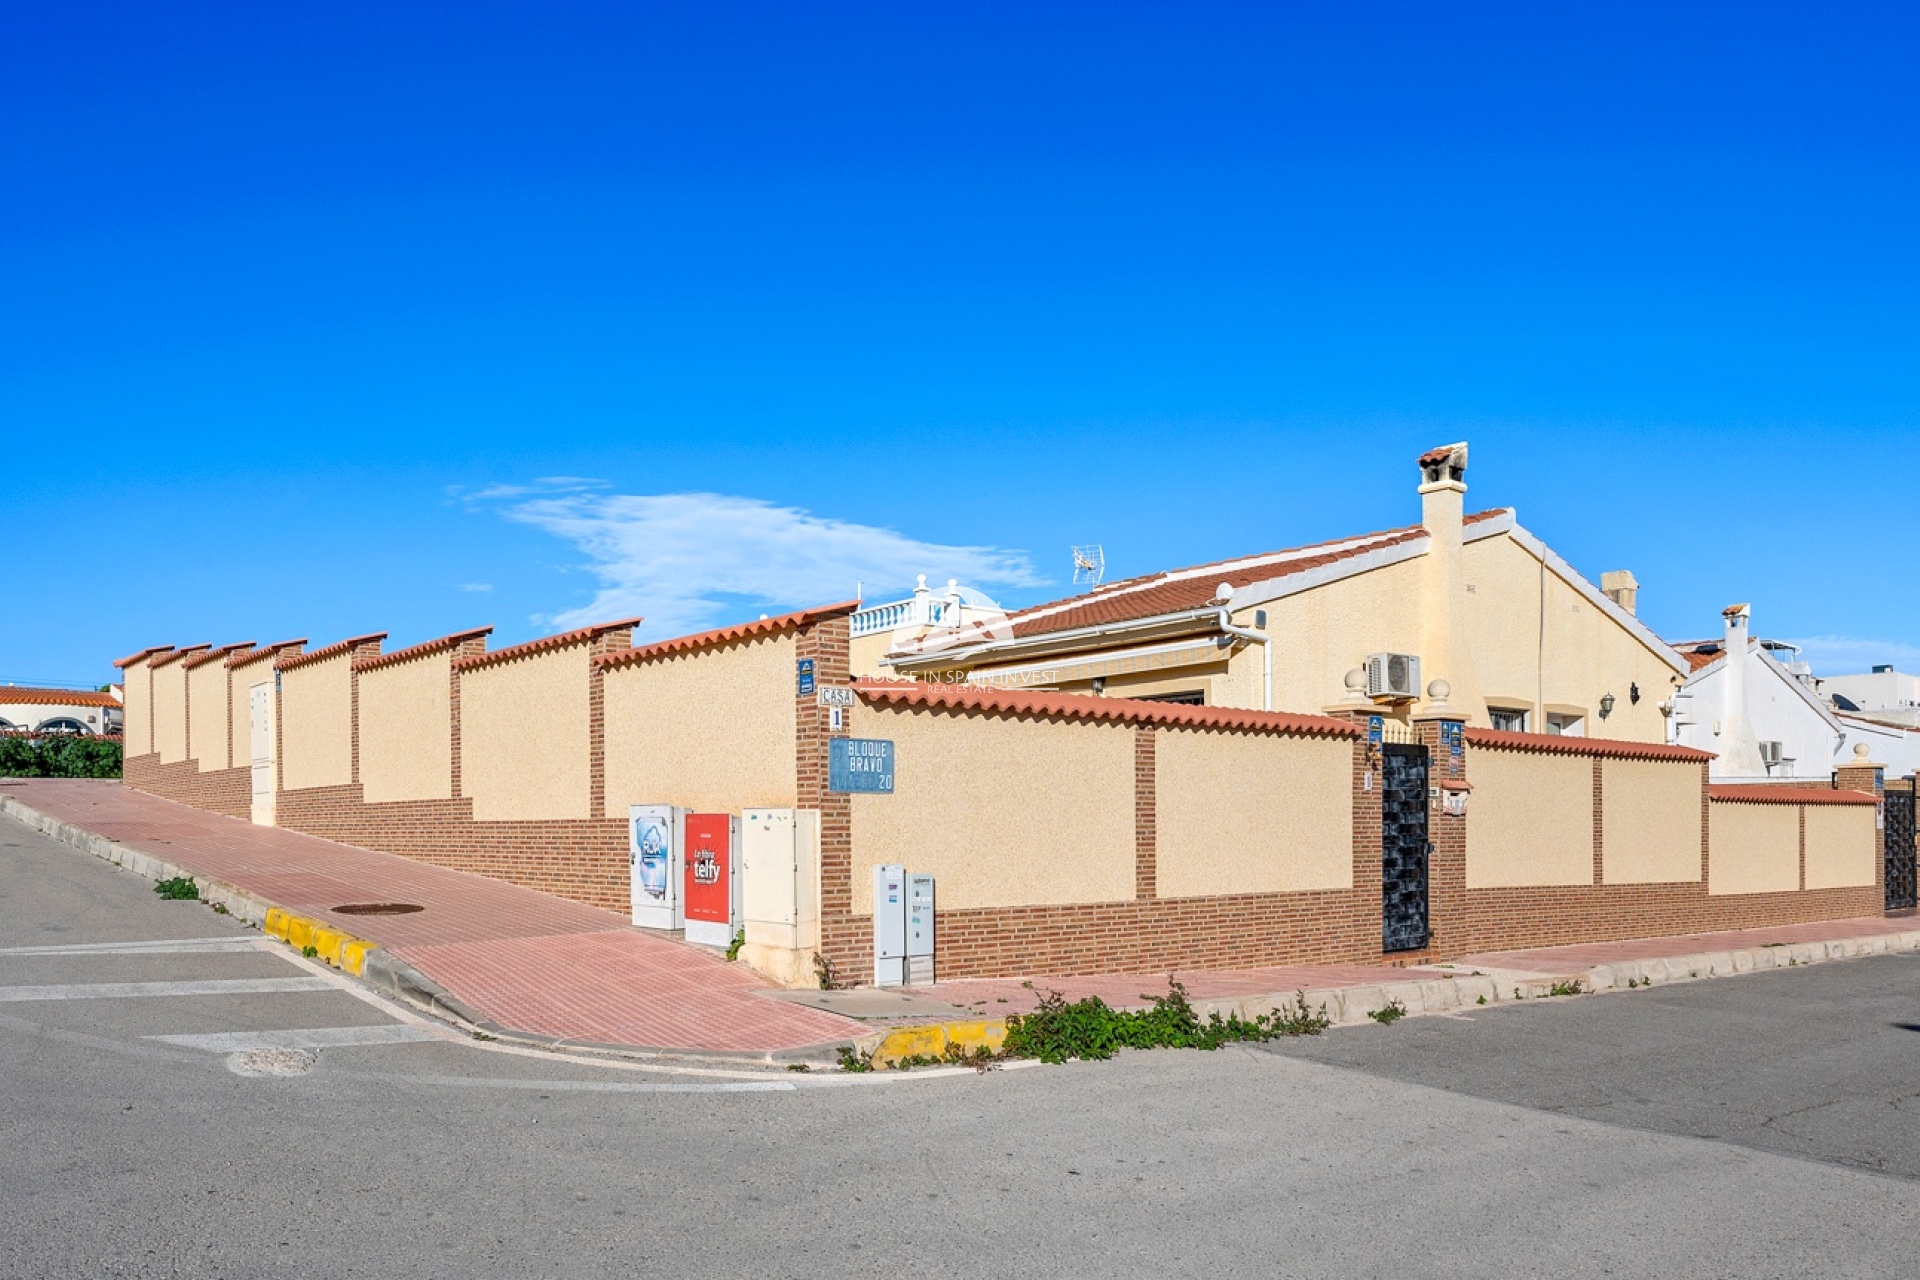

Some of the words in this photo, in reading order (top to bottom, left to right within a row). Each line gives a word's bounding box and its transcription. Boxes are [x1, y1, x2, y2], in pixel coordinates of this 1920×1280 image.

[823, 687, 850, 704] CASA
[834, 710, 840, 726] 1
[848, 741, 887, 757] BLOQUE
[850, 757, 883, 772] BRAVO
[878, 774, 892, 789] 20
[694, 859, 721, 883] telfy
